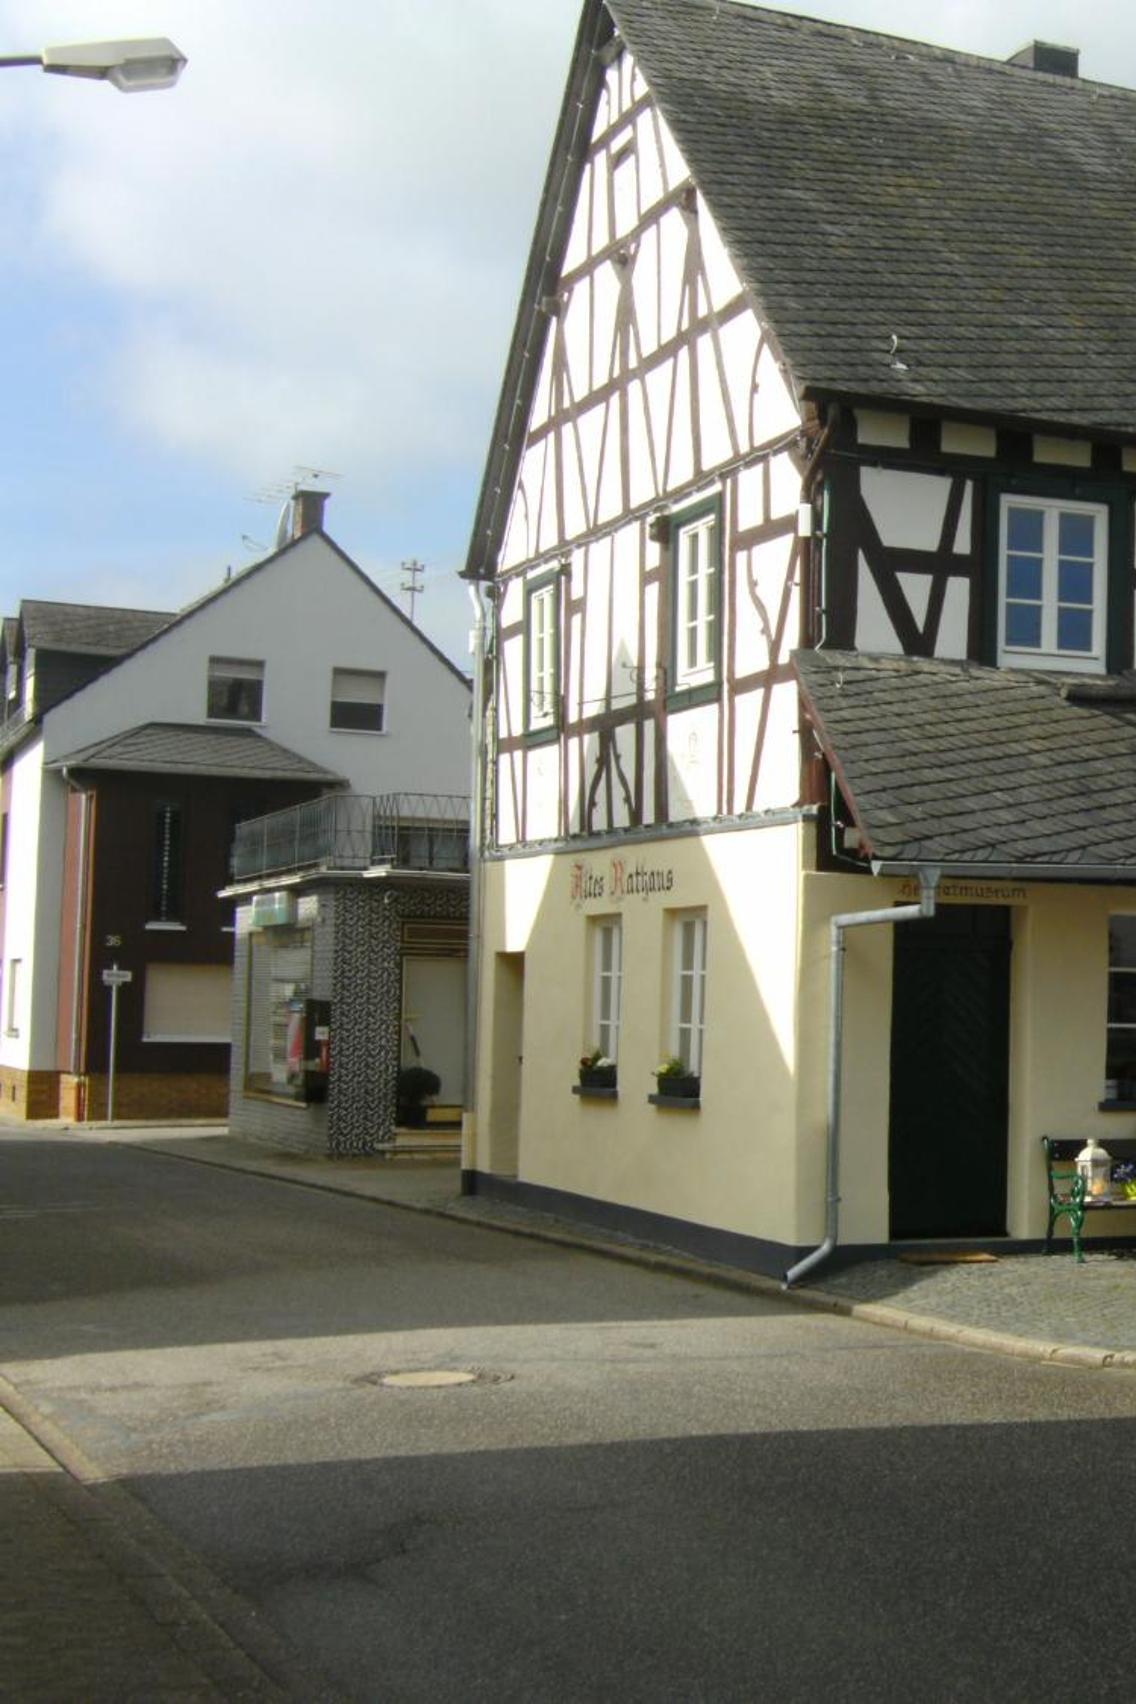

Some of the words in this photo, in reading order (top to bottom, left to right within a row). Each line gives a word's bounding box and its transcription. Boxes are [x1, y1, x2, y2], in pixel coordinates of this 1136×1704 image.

[570, 862, 604, 901] Altes
[610, 859, 674, 900] Rathaus
[898, 882, 1027, 899] Heatmuseum
